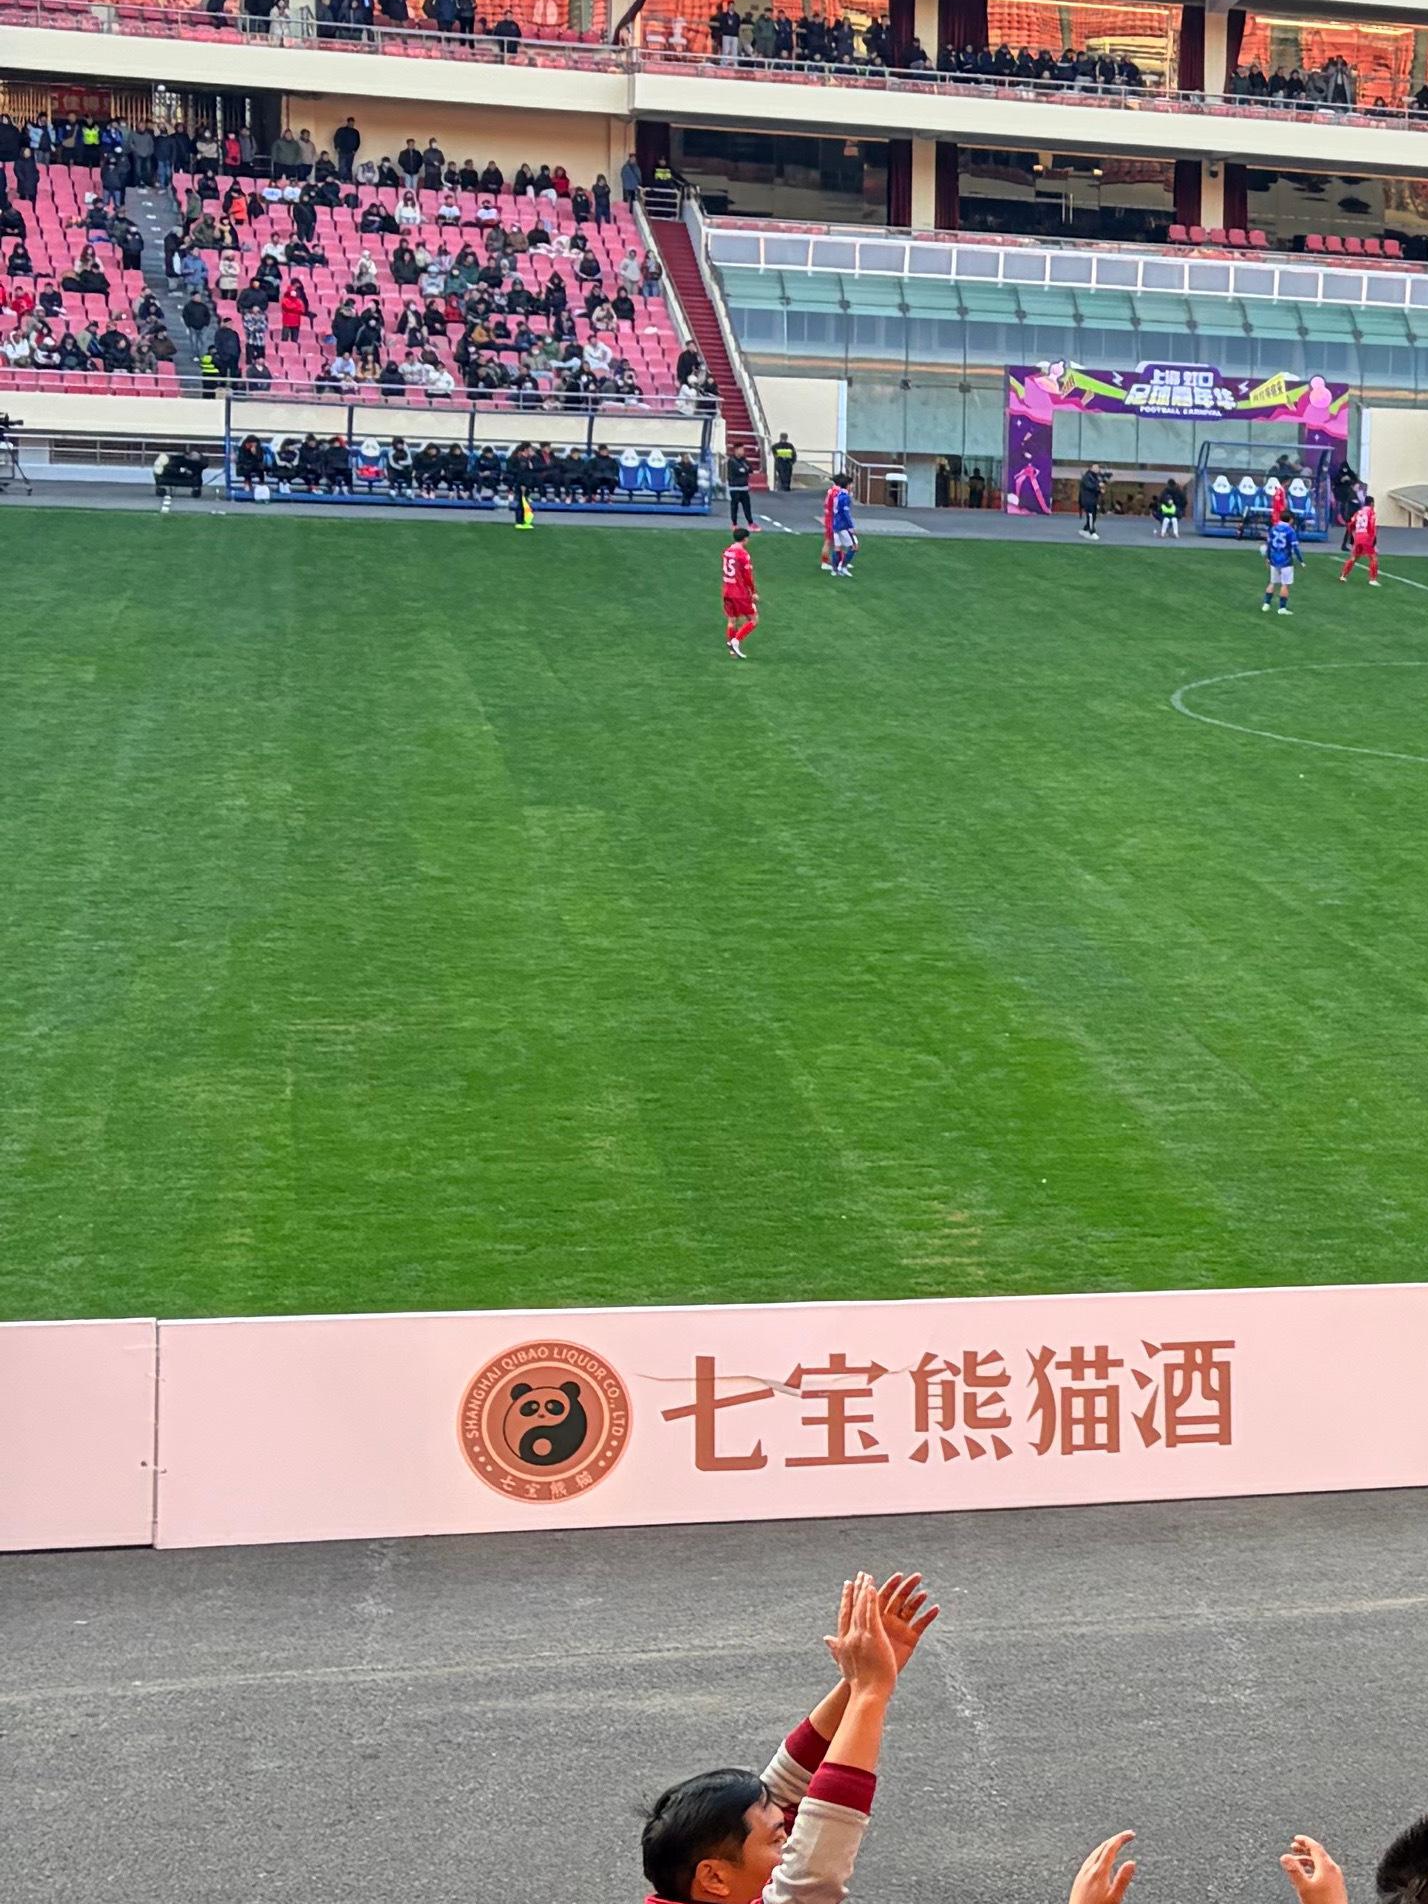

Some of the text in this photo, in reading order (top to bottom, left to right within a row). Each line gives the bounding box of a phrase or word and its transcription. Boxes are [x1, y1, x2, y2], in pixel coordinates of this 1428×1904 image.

[465, 1366, 502, 1439] SHANGHAI
[501, 1345, 549, 1370] QIBAO
[553, 1346, 608, 1381] LIQUOR
[611, 1410, 626, 1437] LTD
[660, 1339, 1236, 1472] 七宝熊猫酒
